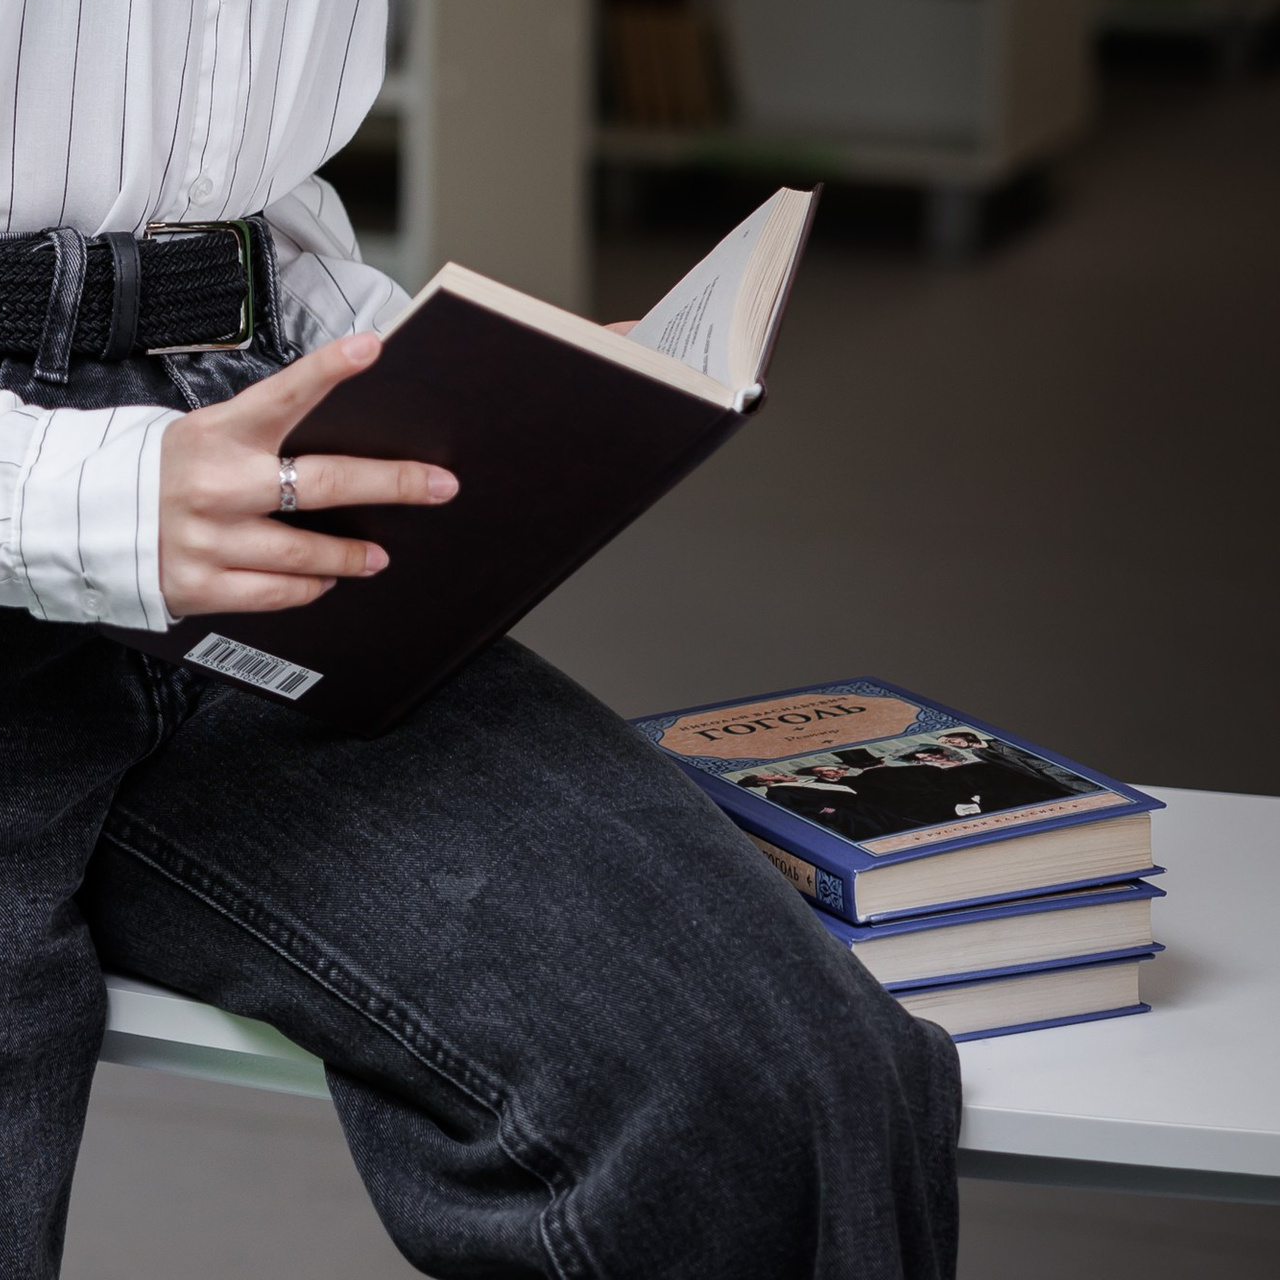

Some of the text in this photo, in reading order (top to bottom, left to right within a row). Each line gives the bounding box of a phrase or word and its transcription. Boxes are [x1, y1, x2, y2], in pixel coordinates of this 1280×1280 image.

[680, 696, 849, 732] НИКОЛАЙ ВАСИЛЬЕВИЧ
[692, 704, 867, 742] ГОГОЛЬ
